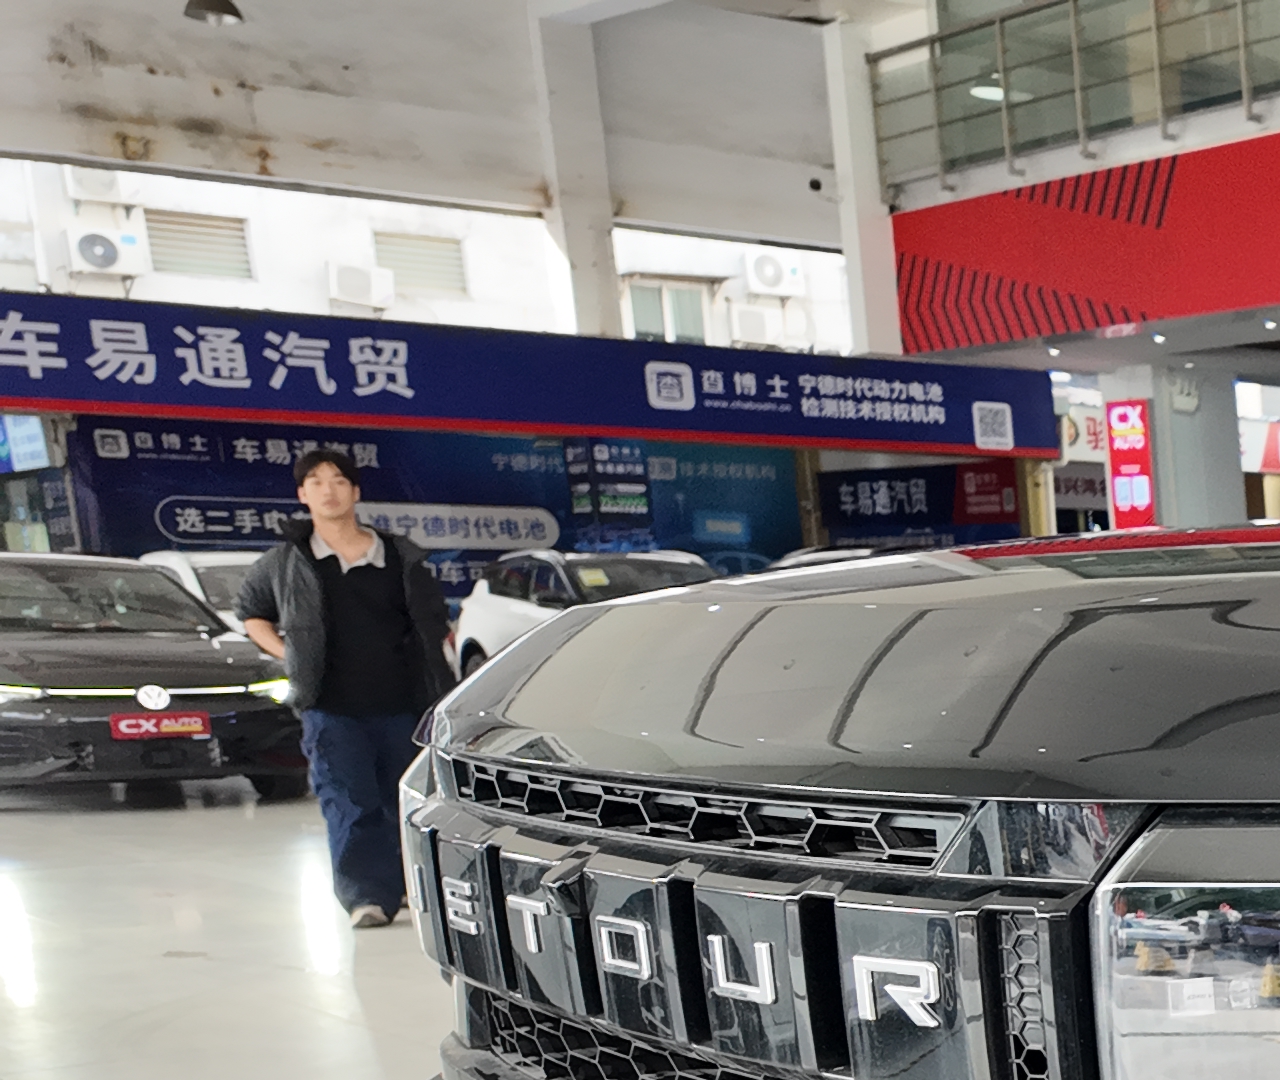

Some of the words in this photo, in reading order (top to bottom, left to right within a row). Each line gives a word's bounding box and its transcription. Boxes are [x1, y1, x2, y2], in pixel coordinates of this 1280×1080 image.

[0, 310, 415, 399] 车易通汽贸
[1110, 405, 1144, 431] CX
[1113, 435, 1146, 451] AUTO
[117, 718, 159, 734] CX
[160, 716, 204, 728] AUTO
